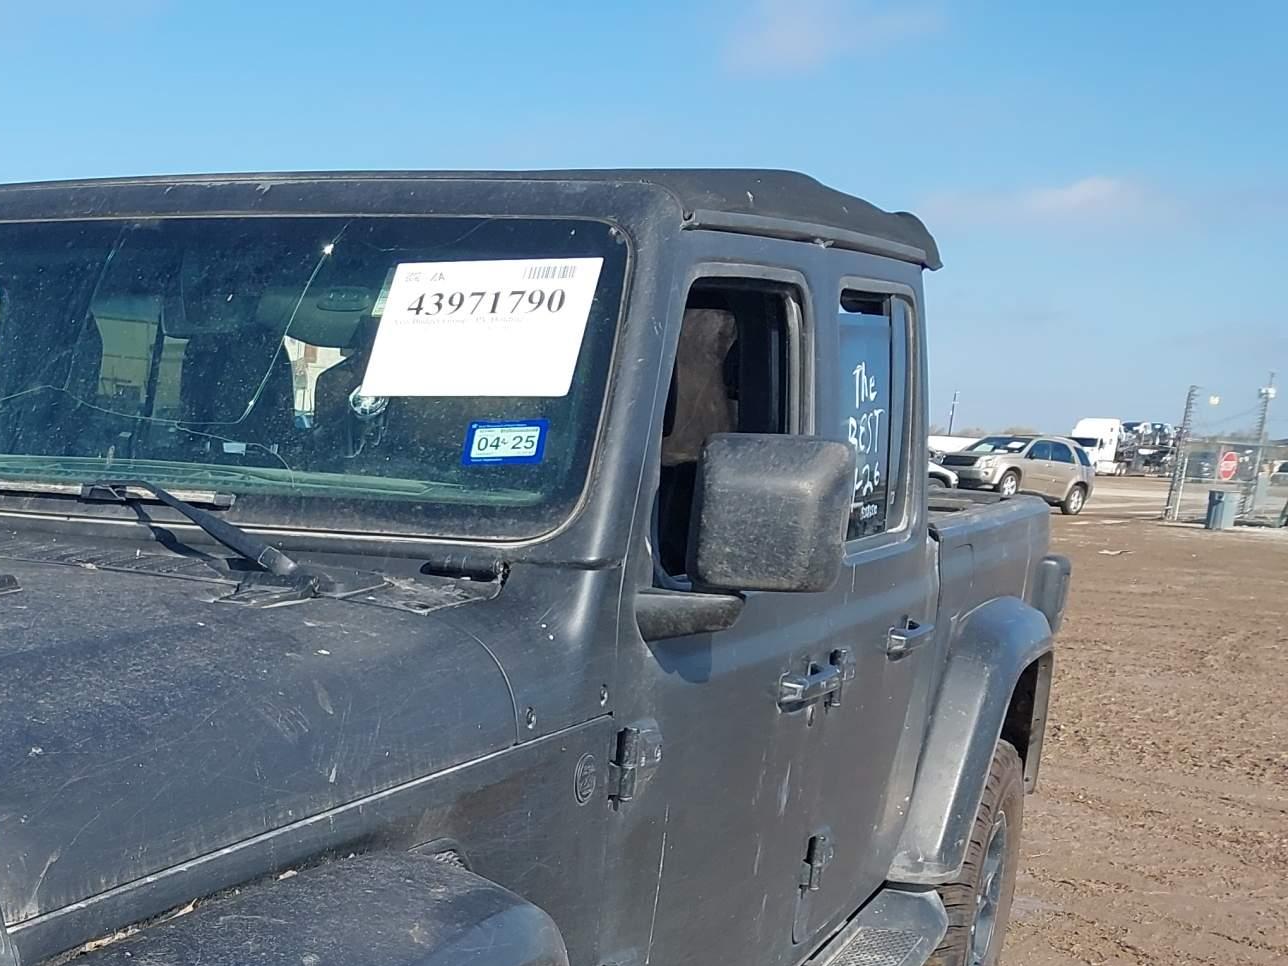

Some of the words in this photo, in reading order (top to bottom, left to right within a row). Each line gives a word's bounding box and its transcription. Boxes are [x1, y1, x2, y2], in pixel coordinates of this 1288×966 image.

[407, 289, 566, 315] 43971790
[852, 361, 878, 409] The
[477, 436, 501, 451] 04
[511, 435, 536, 449] 25
[848, 409, 886, 454] BEST
